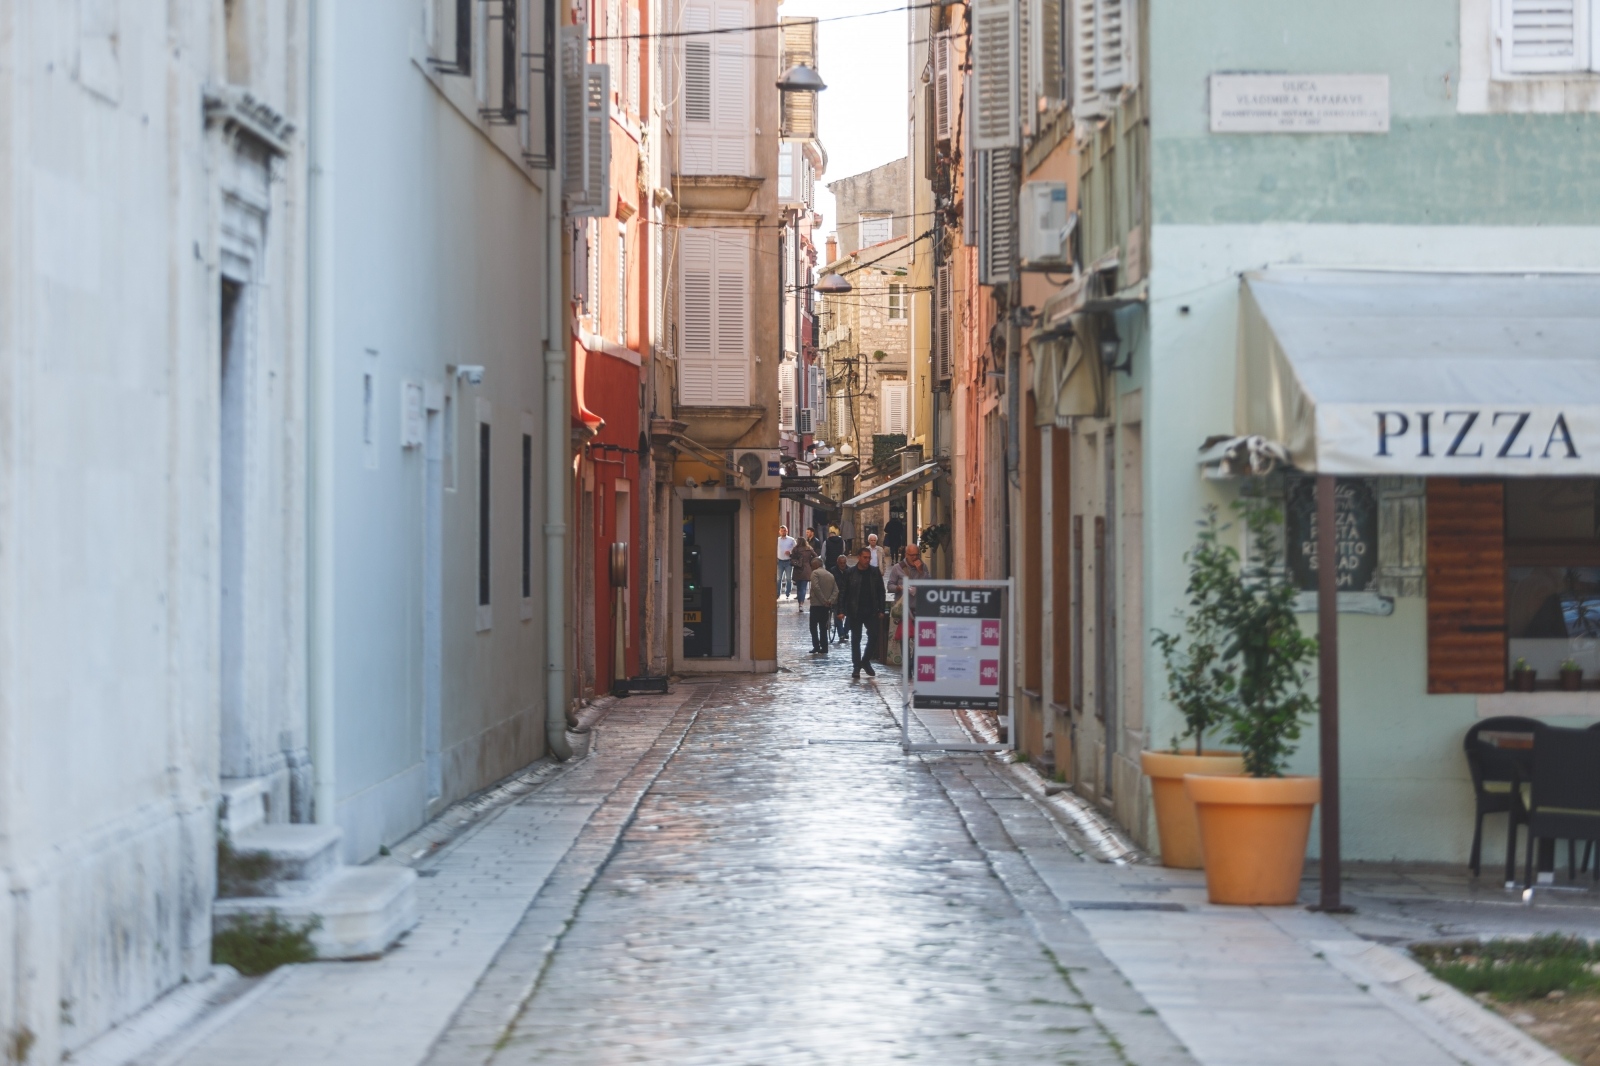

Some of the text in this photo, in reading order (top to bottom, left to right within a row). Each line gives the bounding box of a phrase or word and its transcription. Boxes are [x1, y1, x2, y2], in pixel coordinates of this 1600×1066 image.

[1373, 410, 1582, 459] PIZZA
[1310, 512, 1358, 525] PZA
[1310, 526, 1360, 540] PTA
[1302, 541, 1366, 555] RITTO
[1309, 555, 1360, 570] SAD
[926, 590, 991, 603] OUTLET
[939, 605, 978, 615] SHOES
[918, 663, 935, 674] -70%
